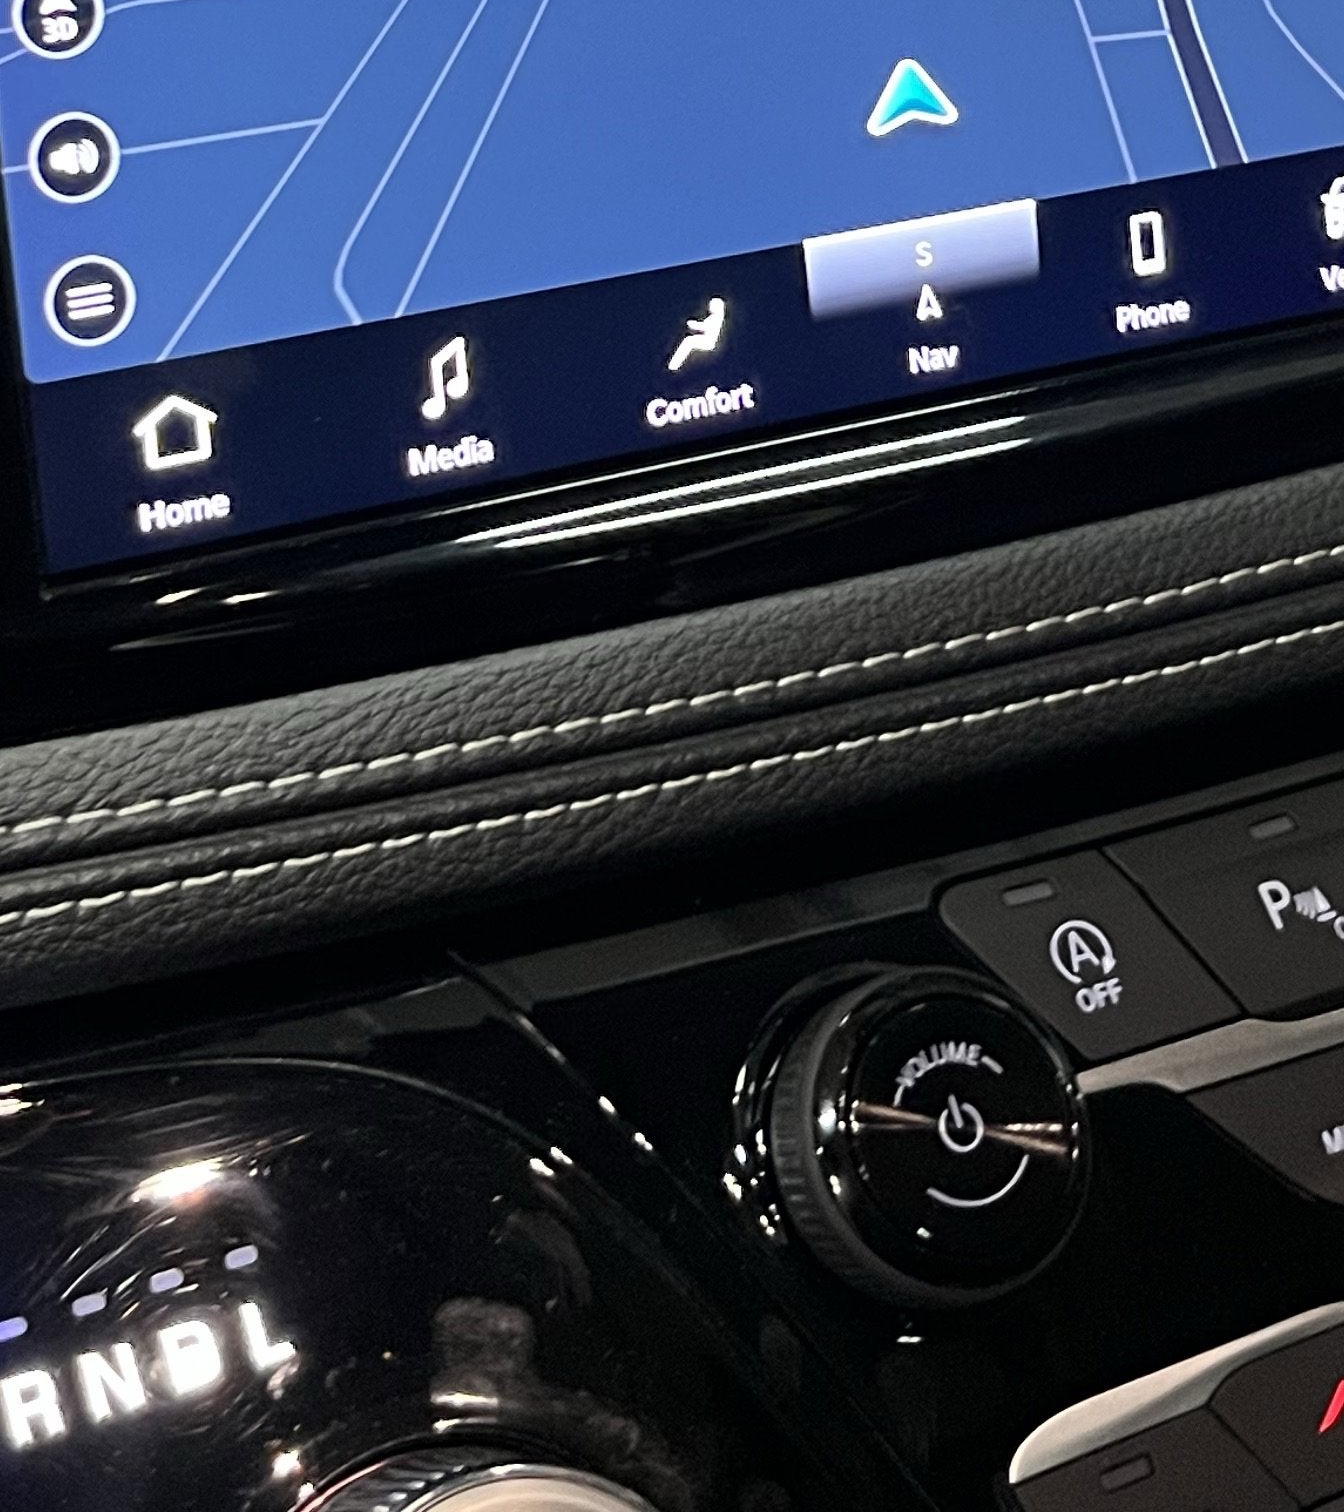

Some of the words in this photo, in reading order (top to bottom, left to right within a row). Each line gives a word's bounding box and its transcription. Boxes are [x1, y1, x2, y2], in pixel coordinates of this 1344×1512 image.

[41, 16, 79, 44] 3D
[1116, 296, 1190, 333] Phone
[908, 345, 960, 375] Nav
[646, 381, 755, 429] Comfort
[407, 434, 494, 478] Media
[138, 491, 231, 533] Home
[1075, 977, 1123, 1013] OFF
